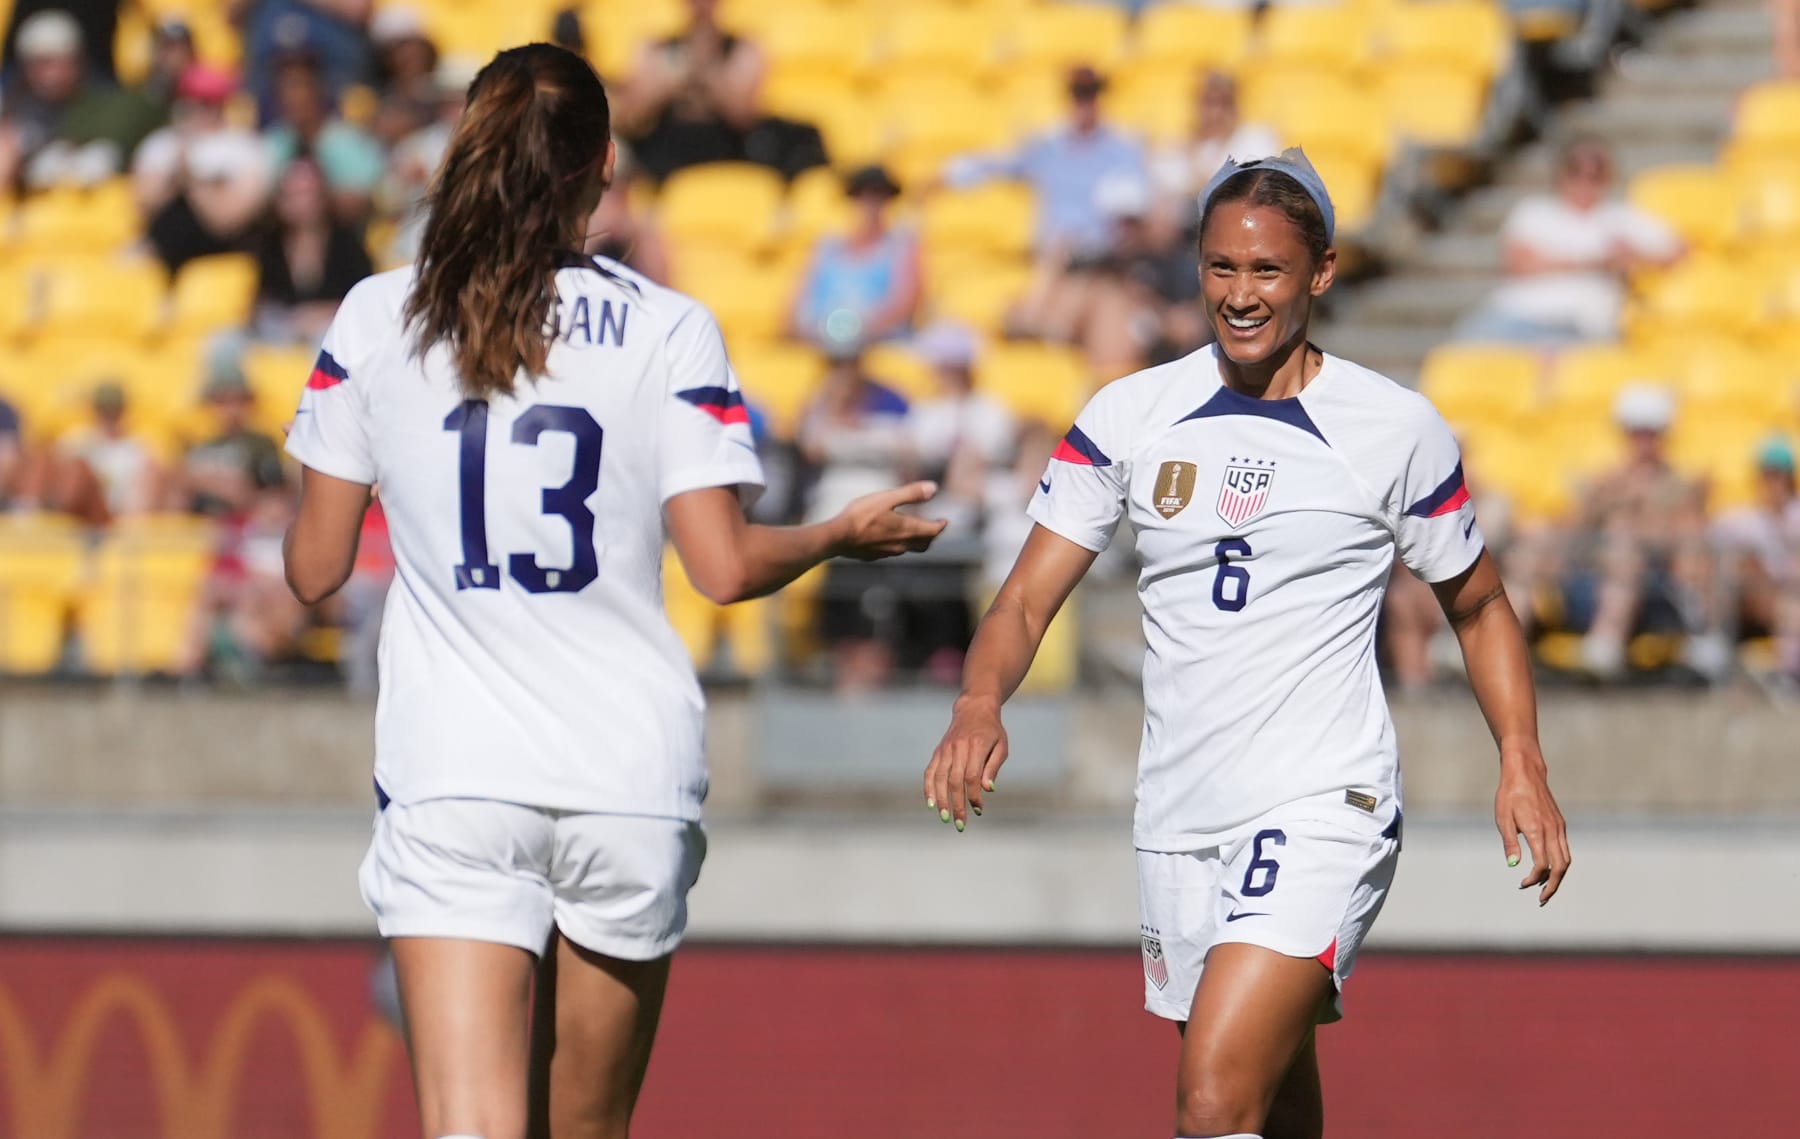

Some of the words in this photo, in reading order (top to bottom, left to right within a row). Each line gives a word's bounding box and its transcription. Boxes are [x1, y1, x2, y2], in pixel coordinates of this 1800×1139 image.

[443, 399, 603, 594] 13
[1228, 470, 1270, 494] USA
[1212, 538, 1252, 612] 6
[1241, 829, 1287, 897] 6
[1144, 938, 1162, 959] USA
